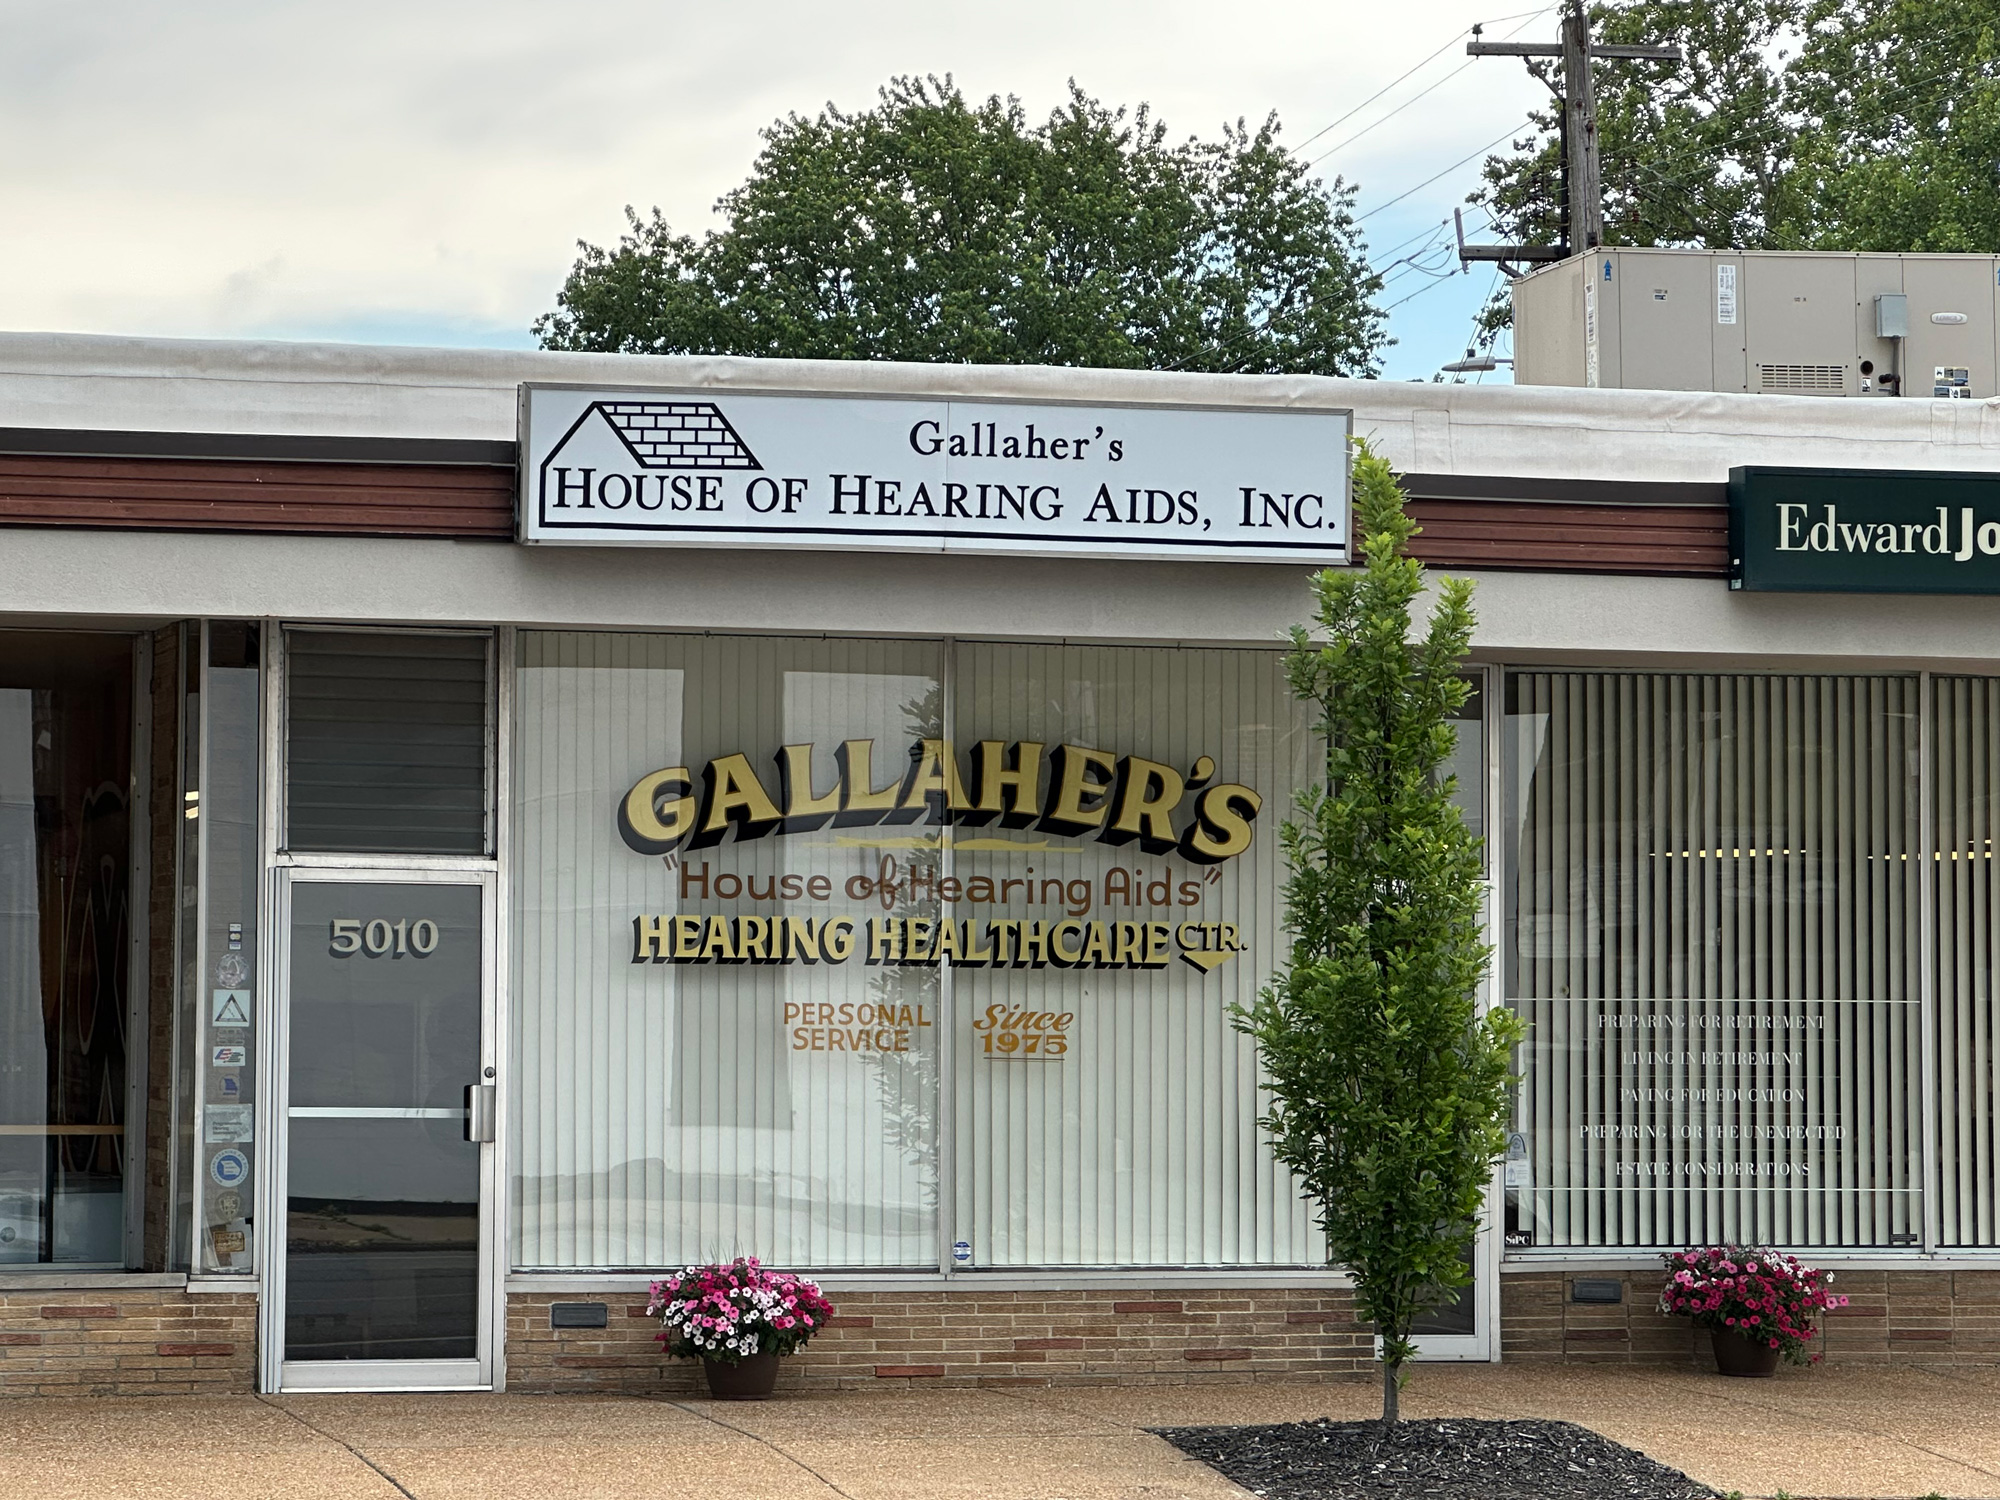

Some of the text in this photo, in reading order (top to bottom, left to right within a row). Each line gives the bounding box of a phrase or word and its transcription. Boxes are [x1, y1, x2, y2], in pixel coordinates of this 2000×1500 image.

[910, 420, 1125, 462] Gallaher's
[553, 467, 1337, 533] HOUSE OF HEARING AIDS, INC.
[618, 738, 1263, 864] GALLAHER'S
[845, 853, 903, 911] of
[909, 864, 1092, 916] Hearing
[329, 918, 439, 959] 5010
[631, 914, 1249, 970] HEARING HEALTHCARE CTR.
[783, 1002, 932, 1028] PERSONAL
[973, 1003, 1075, 1033] Since
[1598, 1014, 1827, 1029] PREPARING FOR RETIREMENT
[792, 1028, 910, 1053] SERVICE
[980, 1034, 1069, 1056] 1975
[1623, 1051, 1803, 1065] LIVING IN RETIREMENT
[1620, 1088, 1806, 1102] PAYING FOR EDUCATION
[1579, 1125, 1847, 1139] PREPARING FOR THE UNEXPECTED
[1615, 1161, 1811, 1176] ESTATE CONSIDERATIONS
